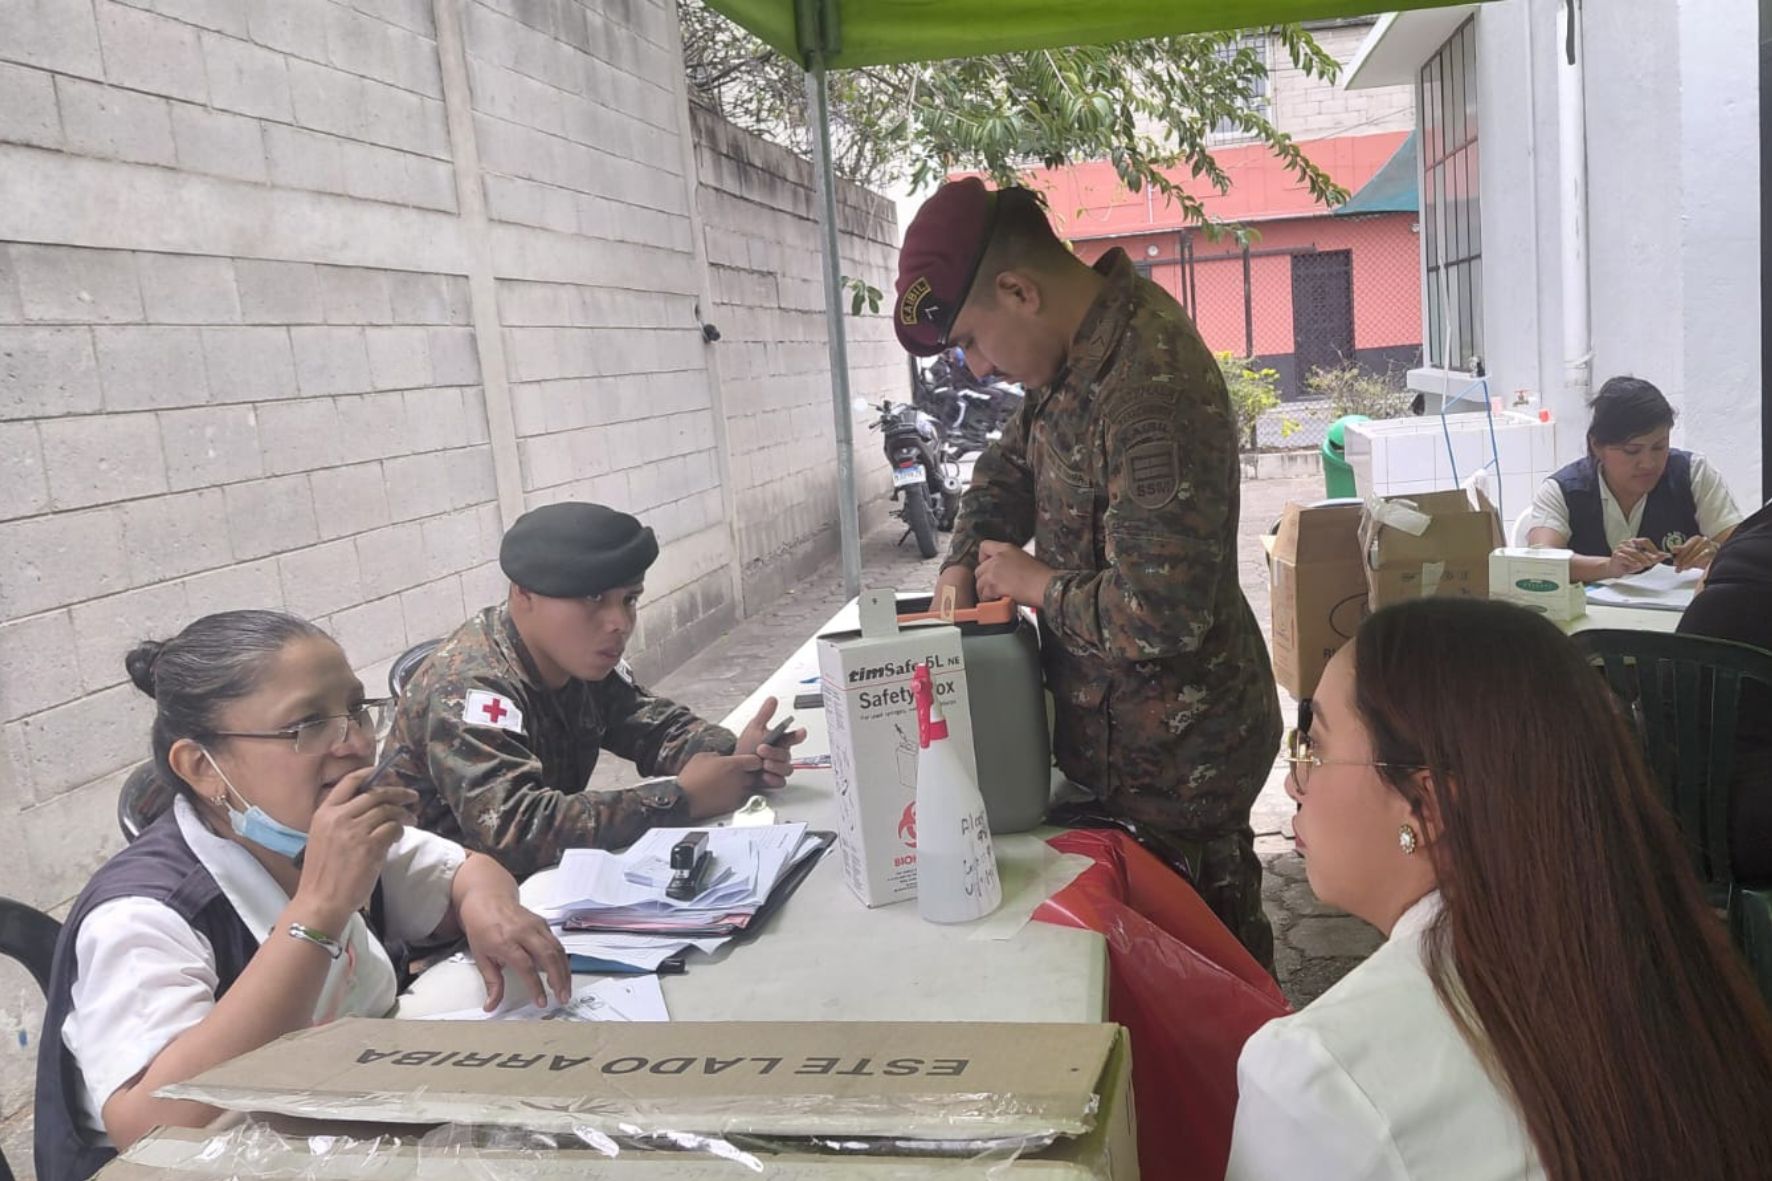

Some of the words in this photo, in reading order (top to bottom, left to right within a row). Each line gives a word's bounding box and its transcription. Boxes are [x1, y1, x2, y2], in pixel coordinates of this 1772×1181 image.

[902, 280, 928, 322] KAIBIL
[947, 656, 960, 666] NE
[859, 686, 914, 709] Safety
[936, 681, 955, 695] ox
[356, 1049, 591, 1071] ARRIBA
[601, 1057, 783, 1074] LADO
[794, 1057, 969, 1076] ESTE
